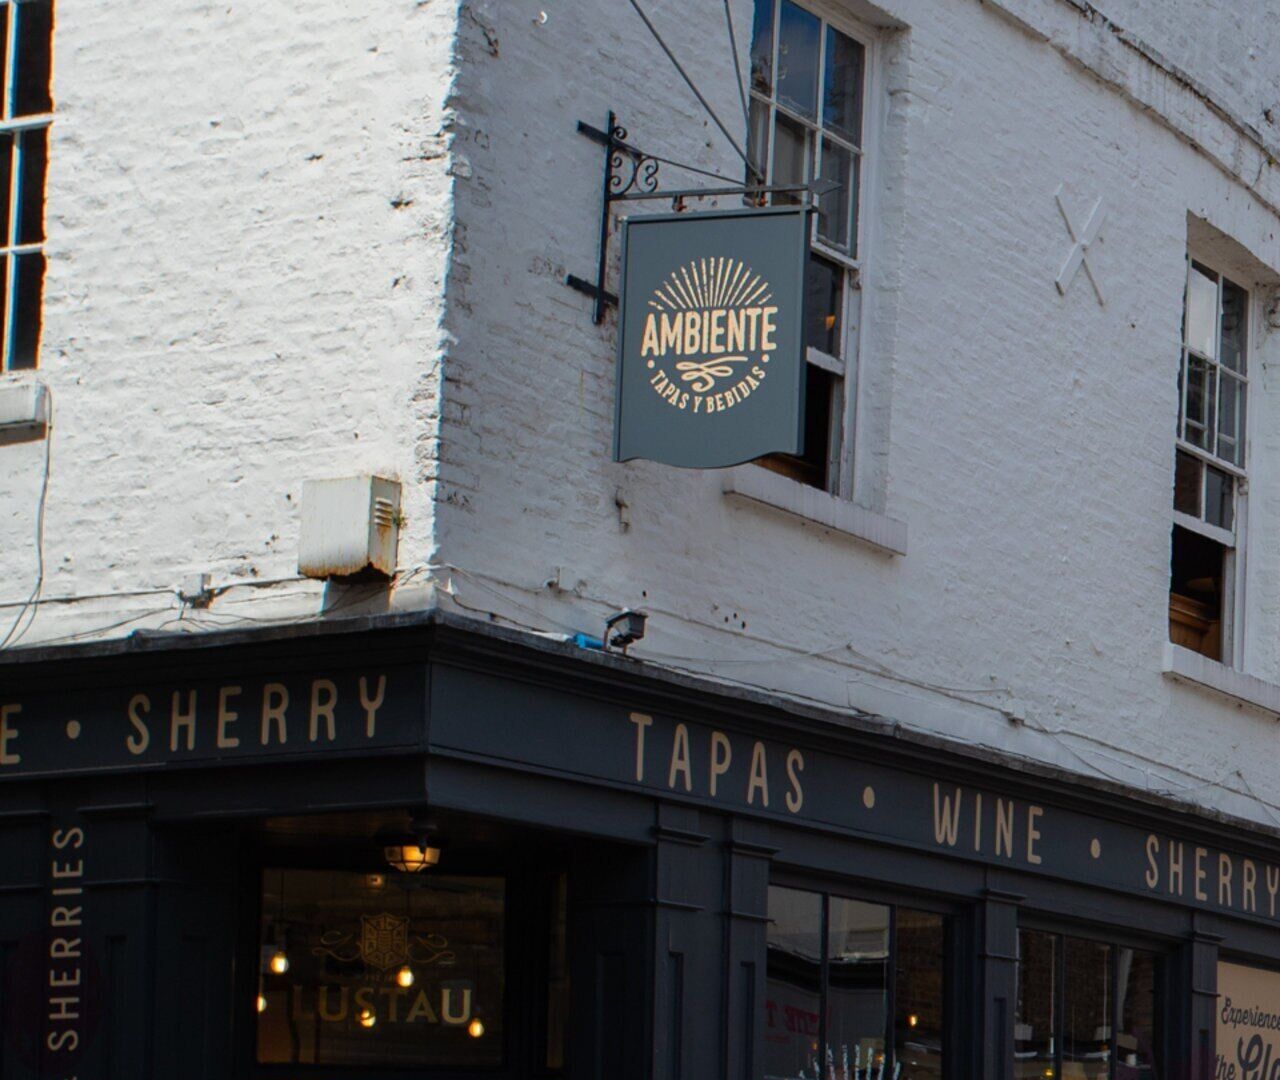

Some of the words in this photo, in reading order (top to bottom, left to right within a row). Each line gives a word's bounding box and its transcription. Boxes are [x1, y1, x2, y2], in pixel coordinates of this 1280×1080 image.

[641, 306, 778, 357] AMBIENTE
[651, 369, 690, 410] TAPAS
[693, 396, 703, 413] Y
[706, 365, 766, 414] BEBIDAS
[126, 675, 387, 755] SHERRY
[630, 712, 805, 813] TAPAS
[932, 781, 1044, 866] WINE
[1144, 833, 1280, 917] SHERRY
[47, 826, 84, 1052] SHERRIES
[293, 985, 472, 1024] LUSTAU
